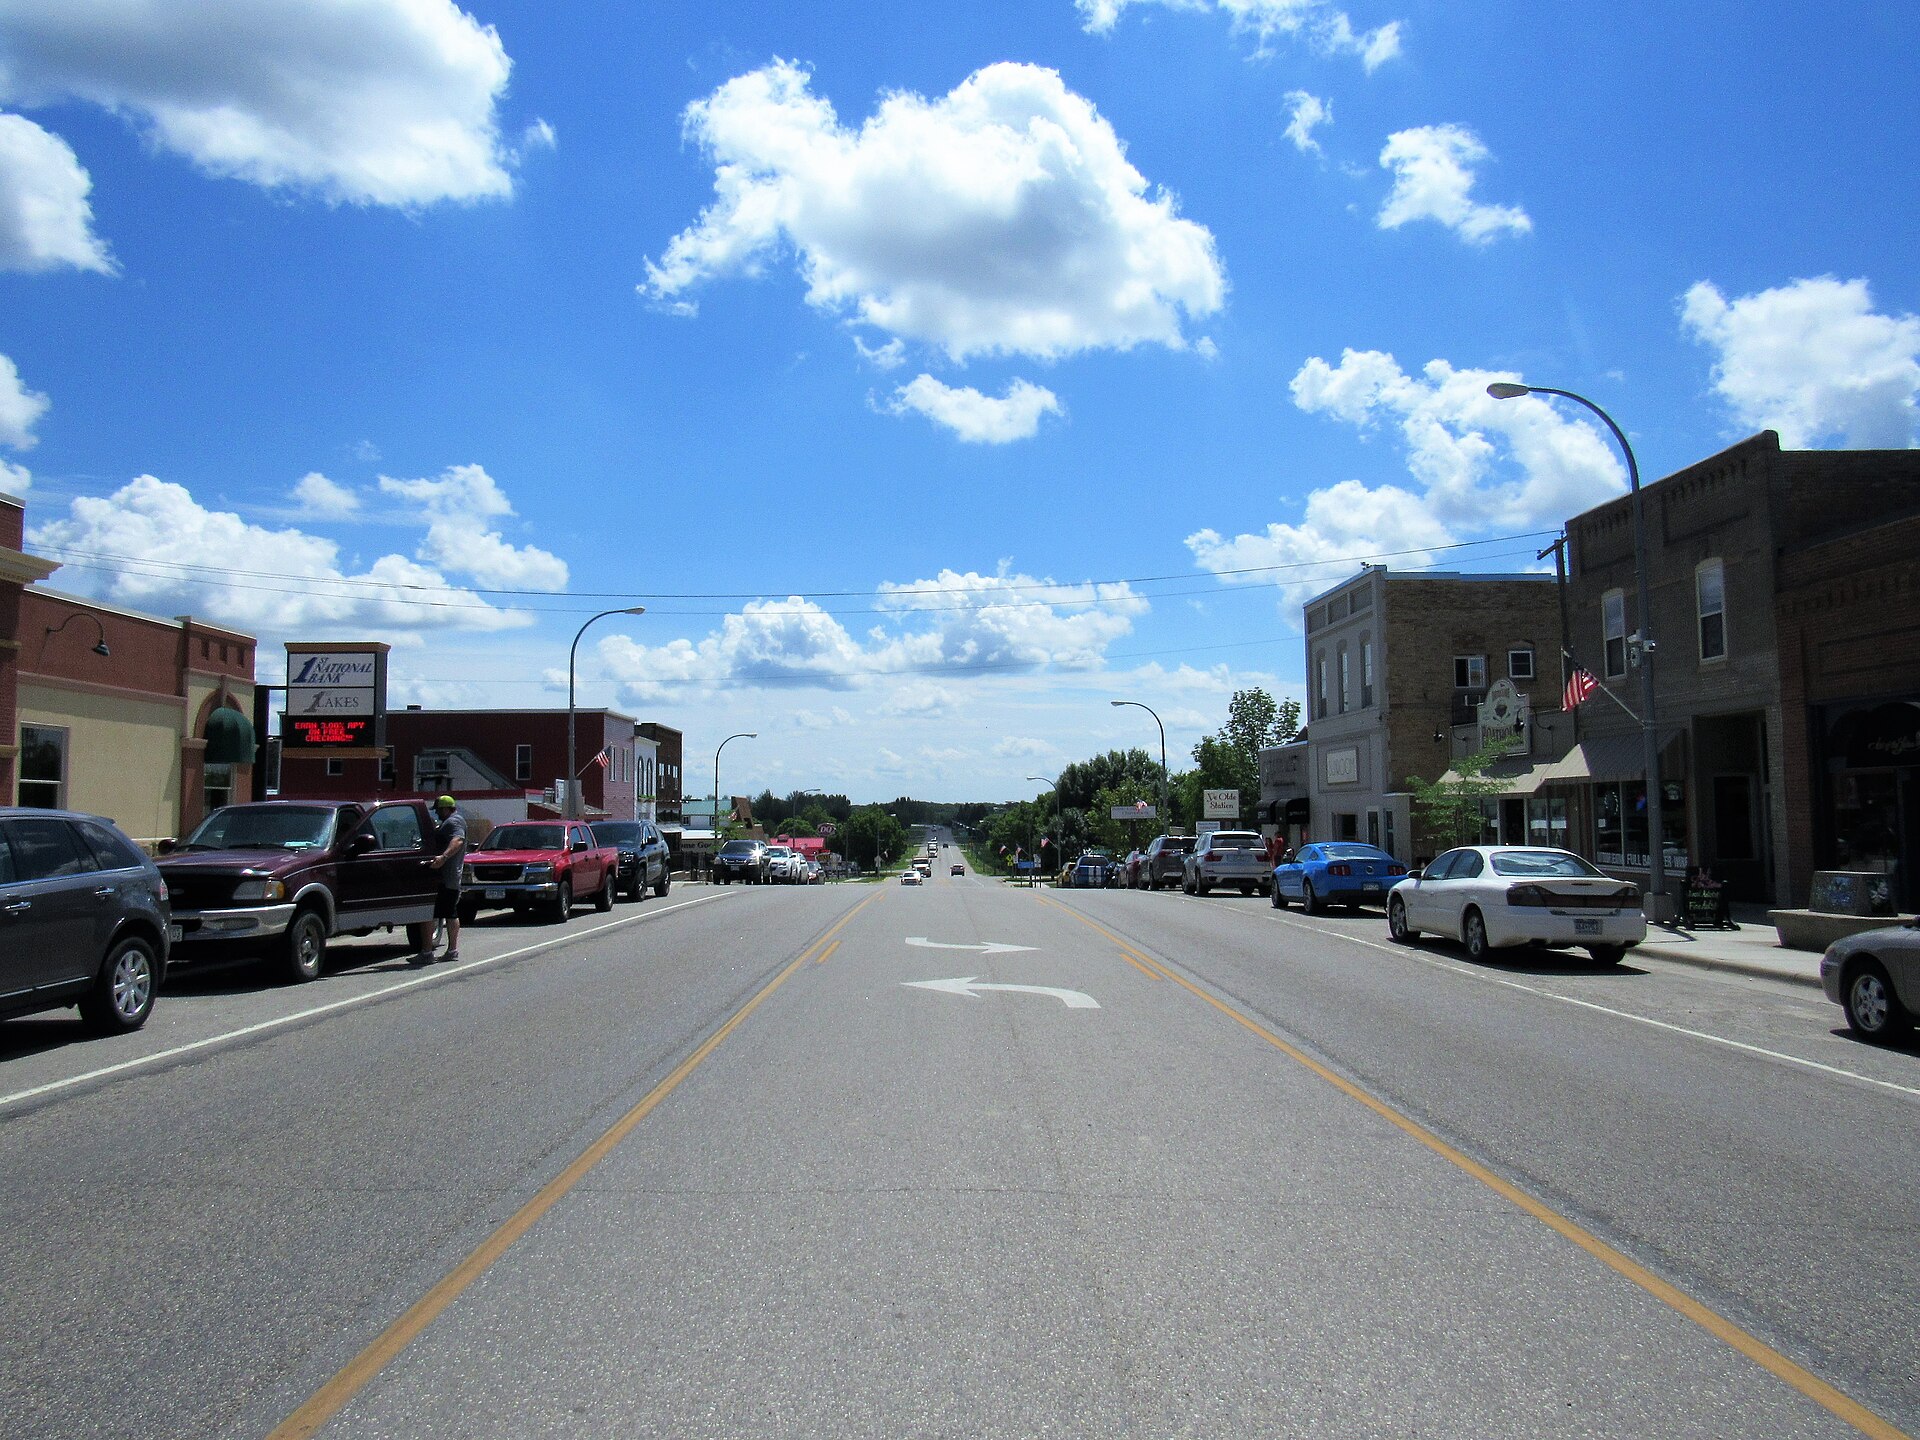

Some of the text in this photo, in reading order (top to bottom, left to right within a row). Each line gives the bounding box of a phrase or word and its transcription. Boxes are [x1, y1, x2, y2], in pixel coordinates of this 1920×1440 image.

[314, 663, 372, 673] NATIONAL
[308, 673, 342, 683] BANK
[317, 697, 359, 708] LAKES
[347, 722, 365, 730] APY
[1206, 793, 1217, 802] Ye
[1626, 854, 1641, 867] FULL
[1642, 855, 1651, 867] BA
